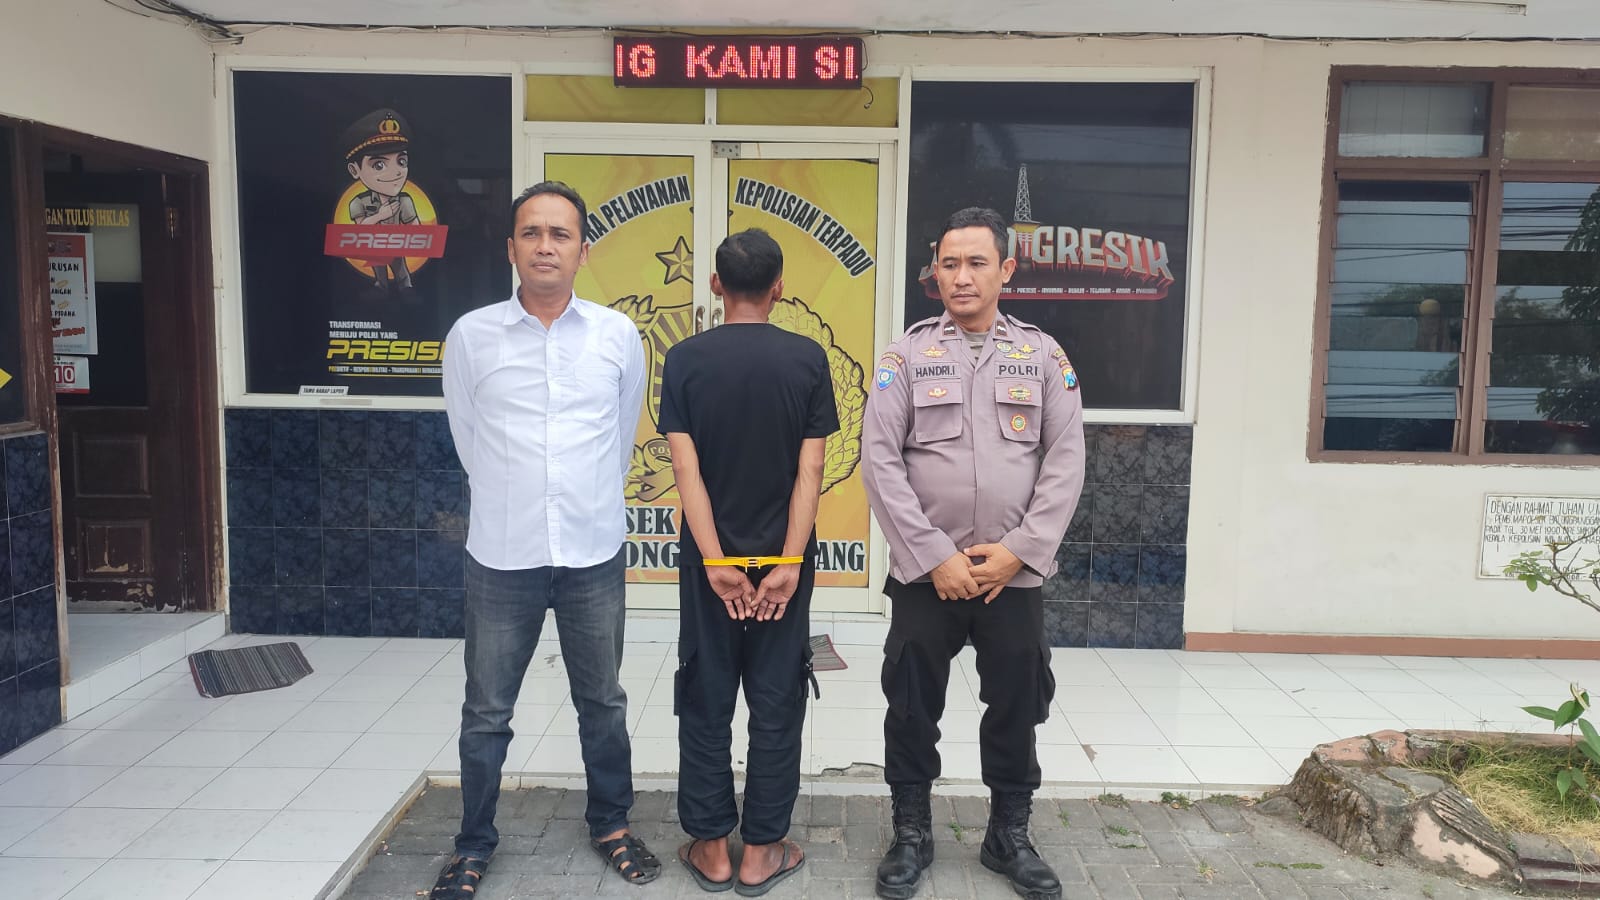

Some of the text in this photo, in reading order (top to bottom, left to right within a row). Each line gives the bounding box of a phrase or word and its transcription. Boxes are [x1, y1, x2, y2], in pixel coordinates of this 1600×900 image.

[686, 44, 796, 79] KAMI
[600, 175, 690, 229] PELAYANAN
[65, 208, 95, 226] TULUS
[735, 177, 820, 232] KEPOLISIAN
[813, 214, 875, 277] TERPADU
[339, 232, 433, 249] PRESISI
[1031, 225, 1175, 282] GRESIK
[329, 320, 382, 329] TRANSFORMASI
[329, 330, 399, 339] MENUJU POLRI YANG
[327, 339, 446, 361] PRESISI
[998, 364, 1039, 376] POLRI
[1490, 500, 1521, 514] DENGAN
[1523, 501, 1554, 515] RAHMAT
[1558, 501, 1585, 515] TUHAN
[815, 541, 866, 571] ANG
